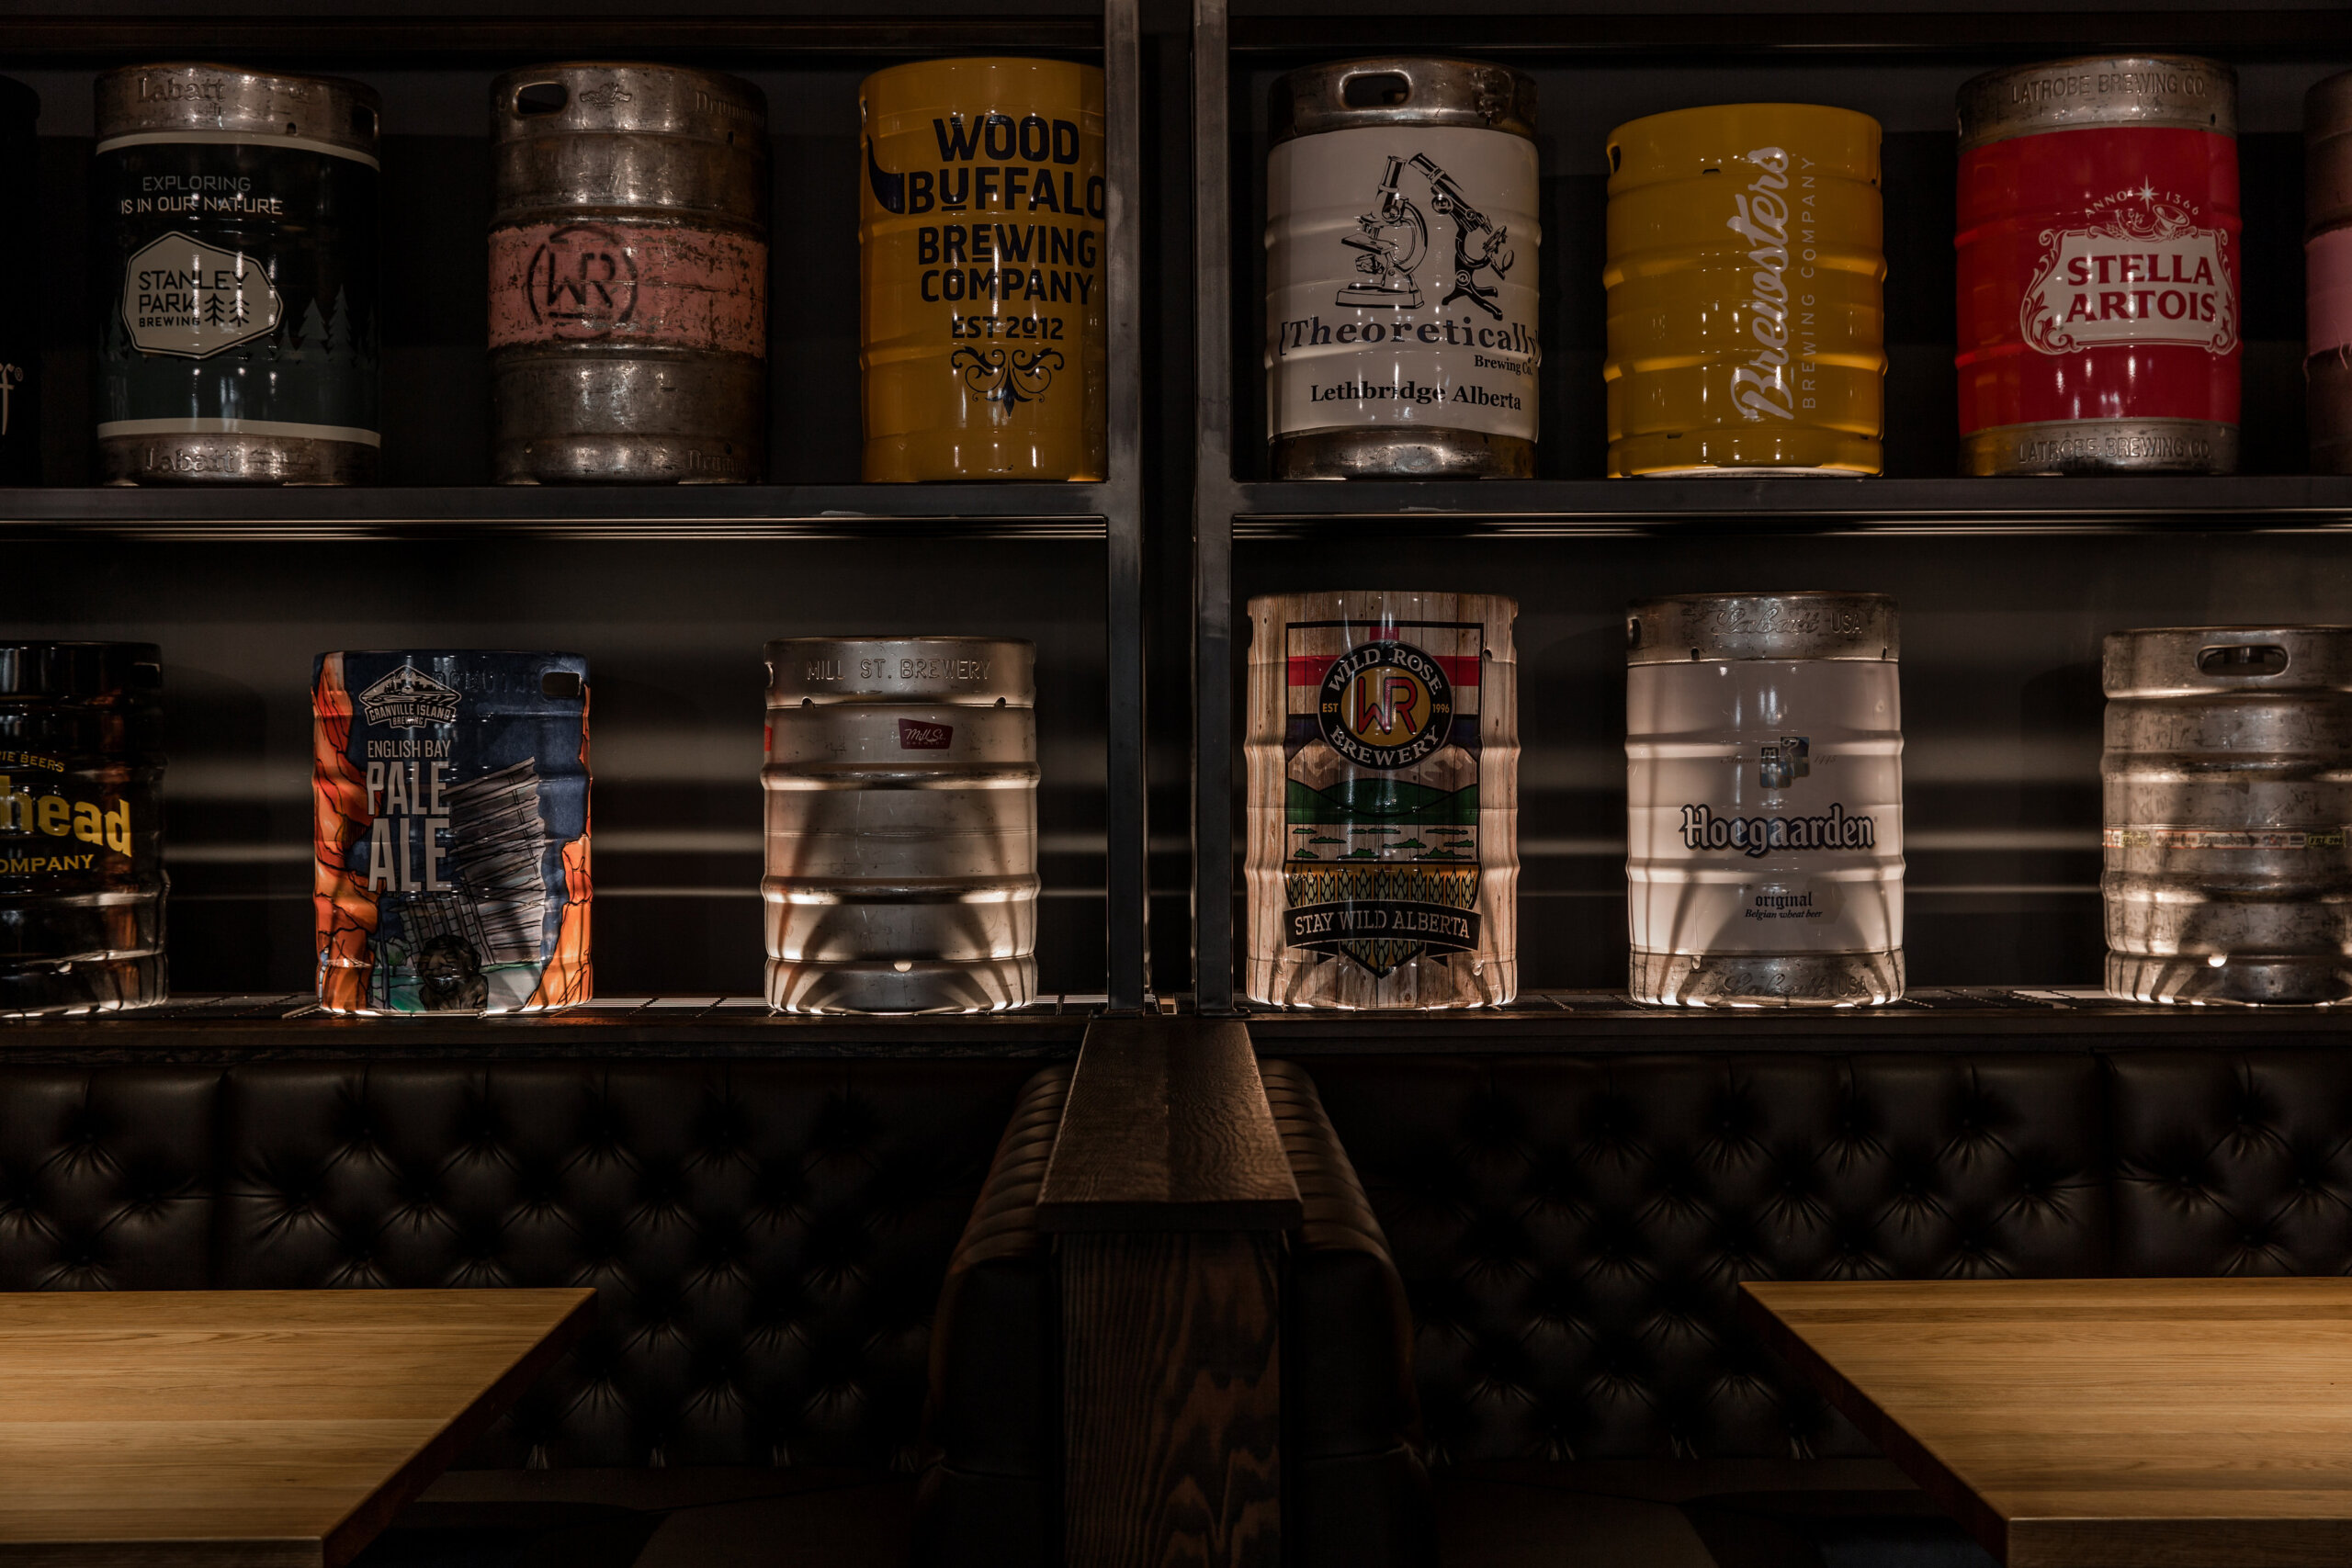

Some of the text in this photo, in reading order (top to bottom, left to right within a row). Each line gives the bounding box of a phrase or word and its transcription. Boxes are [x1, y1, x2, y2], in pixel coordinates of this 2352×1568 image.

[2010, 74, 2091, 105] LATROBE
[2098, 73, 2178, 95] BREWING
[932, 115, 1080, 165] WOOD
[142, 175, 252, 192] EXPLORING
[908, 166, 1106, 220] BUFFALO
[120, 196, 284, 216] IS IN OUR NATURE
[2083, 189, 2200, 220] ANNO 1366
[919, 223, 1097, 269] BREWING
[139, 270, 249, 291] STANLEY
[1725, 145, 1795, 422] Brewsters
[1801, 157, 1816, 410] BREWING COMPANY
[2067, 254, 2215, 287] STELLA
[921, 267, 1094, 306] COMPANY
[139, 293, 198, 314] PARK
[2064, 289, 2217, 323] ARTOIS
[139, 317, 200, 328] BREWING
[951, 315, 1064, 341] EST 2012
[1474, 355, 1533, 377] Brewing Co.
[1310, 380, 1522, 411] Lethbridge Alberta
[2018, 438, 2098, 465] LATROBE
[2105, 436, 2186, 458] BREWING
[1711, 607, 1863, 636] Labatt USA
[807, 658, 991, 681] MILL ST. BREWERY
[1328, 648, 1443, 695] WILD ROSE
[368, 705, 454, 721] GRANVILLE ISLAND
[1322, 703, 1451, 714] EST 1996
[1356, 675, 1419, 736] WR
[392, 716, 424, 727] BREWING
[903, 728, 931, 742] Mill
[368, 739, 452, 759] ENGLISH BAY
[1329, 724, 1440, 767] BREWERY
[19, 753, 67, 773] BEERS
[367, 761, 450, 815] PALE
[1678, 802, 1875, 859] Hoegaarden
[368, 818, 452, 892] ALE
[1745, 908, 1823, 921] Belgian wheat beer
[1755, 891, 1814, 910] original
[1294, 909, 1470, 940] STAY WILD ALBERTA
[1838, 975, 1870, 998] USA
